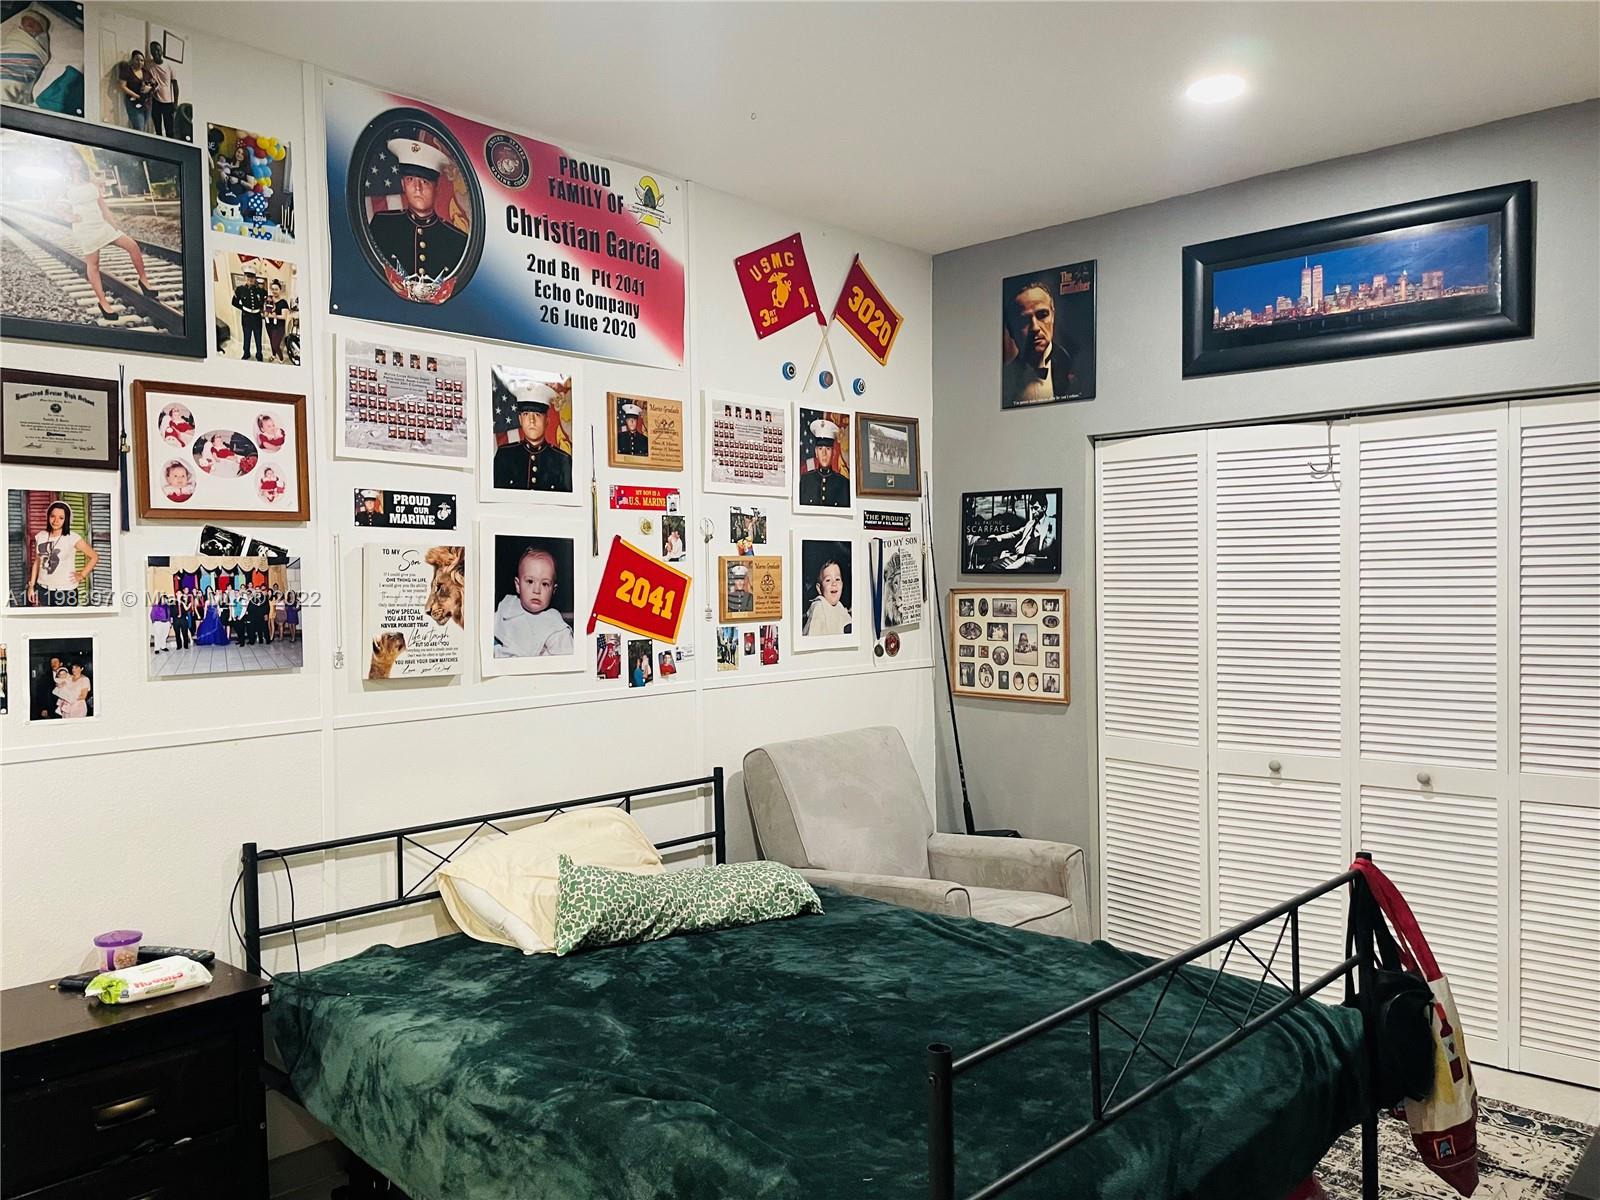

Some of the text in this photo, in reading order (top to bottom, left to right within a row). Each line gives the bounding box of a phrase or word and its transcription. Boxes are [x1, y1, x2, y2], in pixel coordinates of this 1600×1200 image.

[491, 166, 512, 186] MARINE
[559, 156, 611, 188] PROUD
[548, 177, 602, 210] FAMILY
[607, 192, 624, 215] OF
[506, 204, 660, 270] Christian Garcia
[526, 253, 645, 297] 2nd Bn Plt 2041
[749, 251, 795, 282] USMC
[1060, 271, 1073, 283] The
[534, 279, 640, 319] Echo Company
[540, 305, 636, 339] 26 June 2020
[848, 285, 892, 347] 3020
[392, 494, 431, 507] PROUD
[413, 507, 430, 515] OUR
[628, 497, 667, 507] U.S. MARINE
[389, 513, 436, 525] MARINE
[966, 524, 1010, 534] SCARFACE
[883, 537, 918, 549] TO MY SON
[398, 549, 422, 572] Son
[615, 570, 676, 620] 2041
